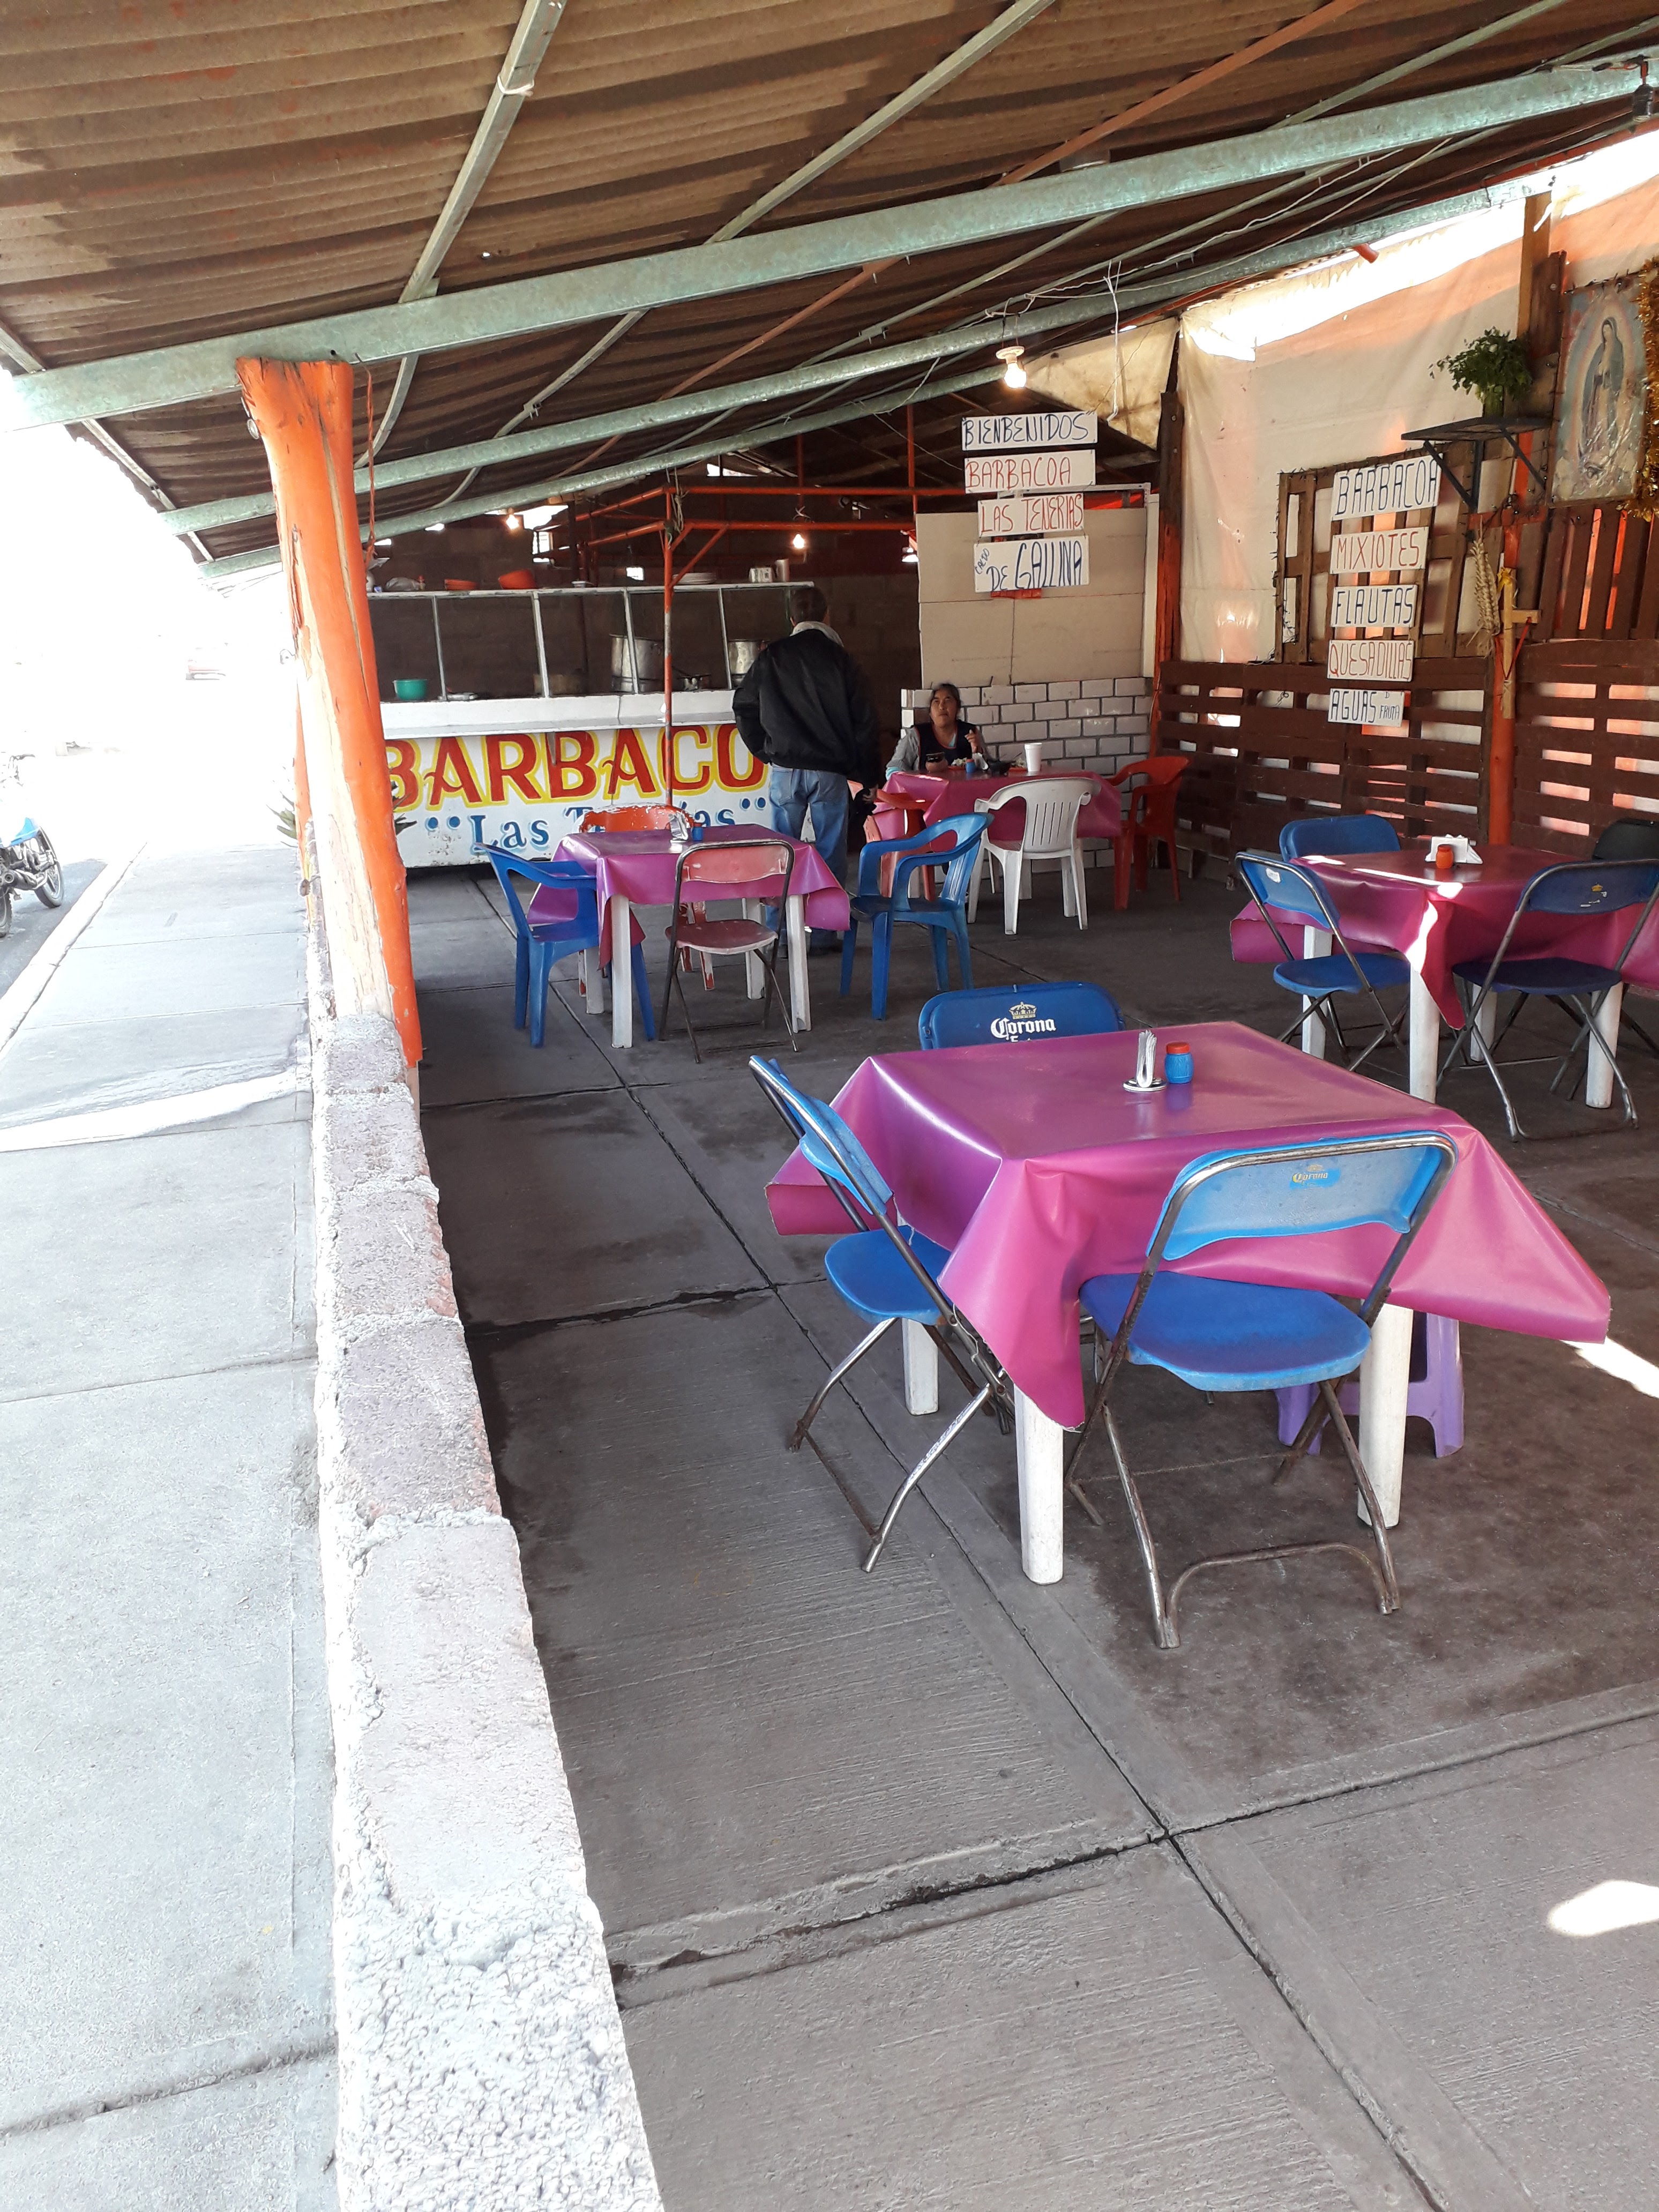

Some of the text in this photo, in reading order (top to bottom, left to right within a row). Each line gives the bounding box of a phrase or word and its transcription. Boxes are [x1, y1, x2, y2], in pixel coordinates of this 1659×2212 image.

[965, 456, 1072, 490] BARBACOA
[1334, 458, 1439, 516] BARBACOA
[981, 493, 1083, 533] LAS TENERIAS
[975, 540, 1083, 592] CALDO DE GALLINA
[1335, 530, 1420, 570] MIXIOTES
[1334, 587, 1414, 625] FLAUTAS
[1329, 642, 1412, 679] QUESADILLAS
[1331, 691, 1377, 723] AGUAS
[385, 724, 768, 813] BARBACO
[990, 1017, 1057, 1041] Corona
